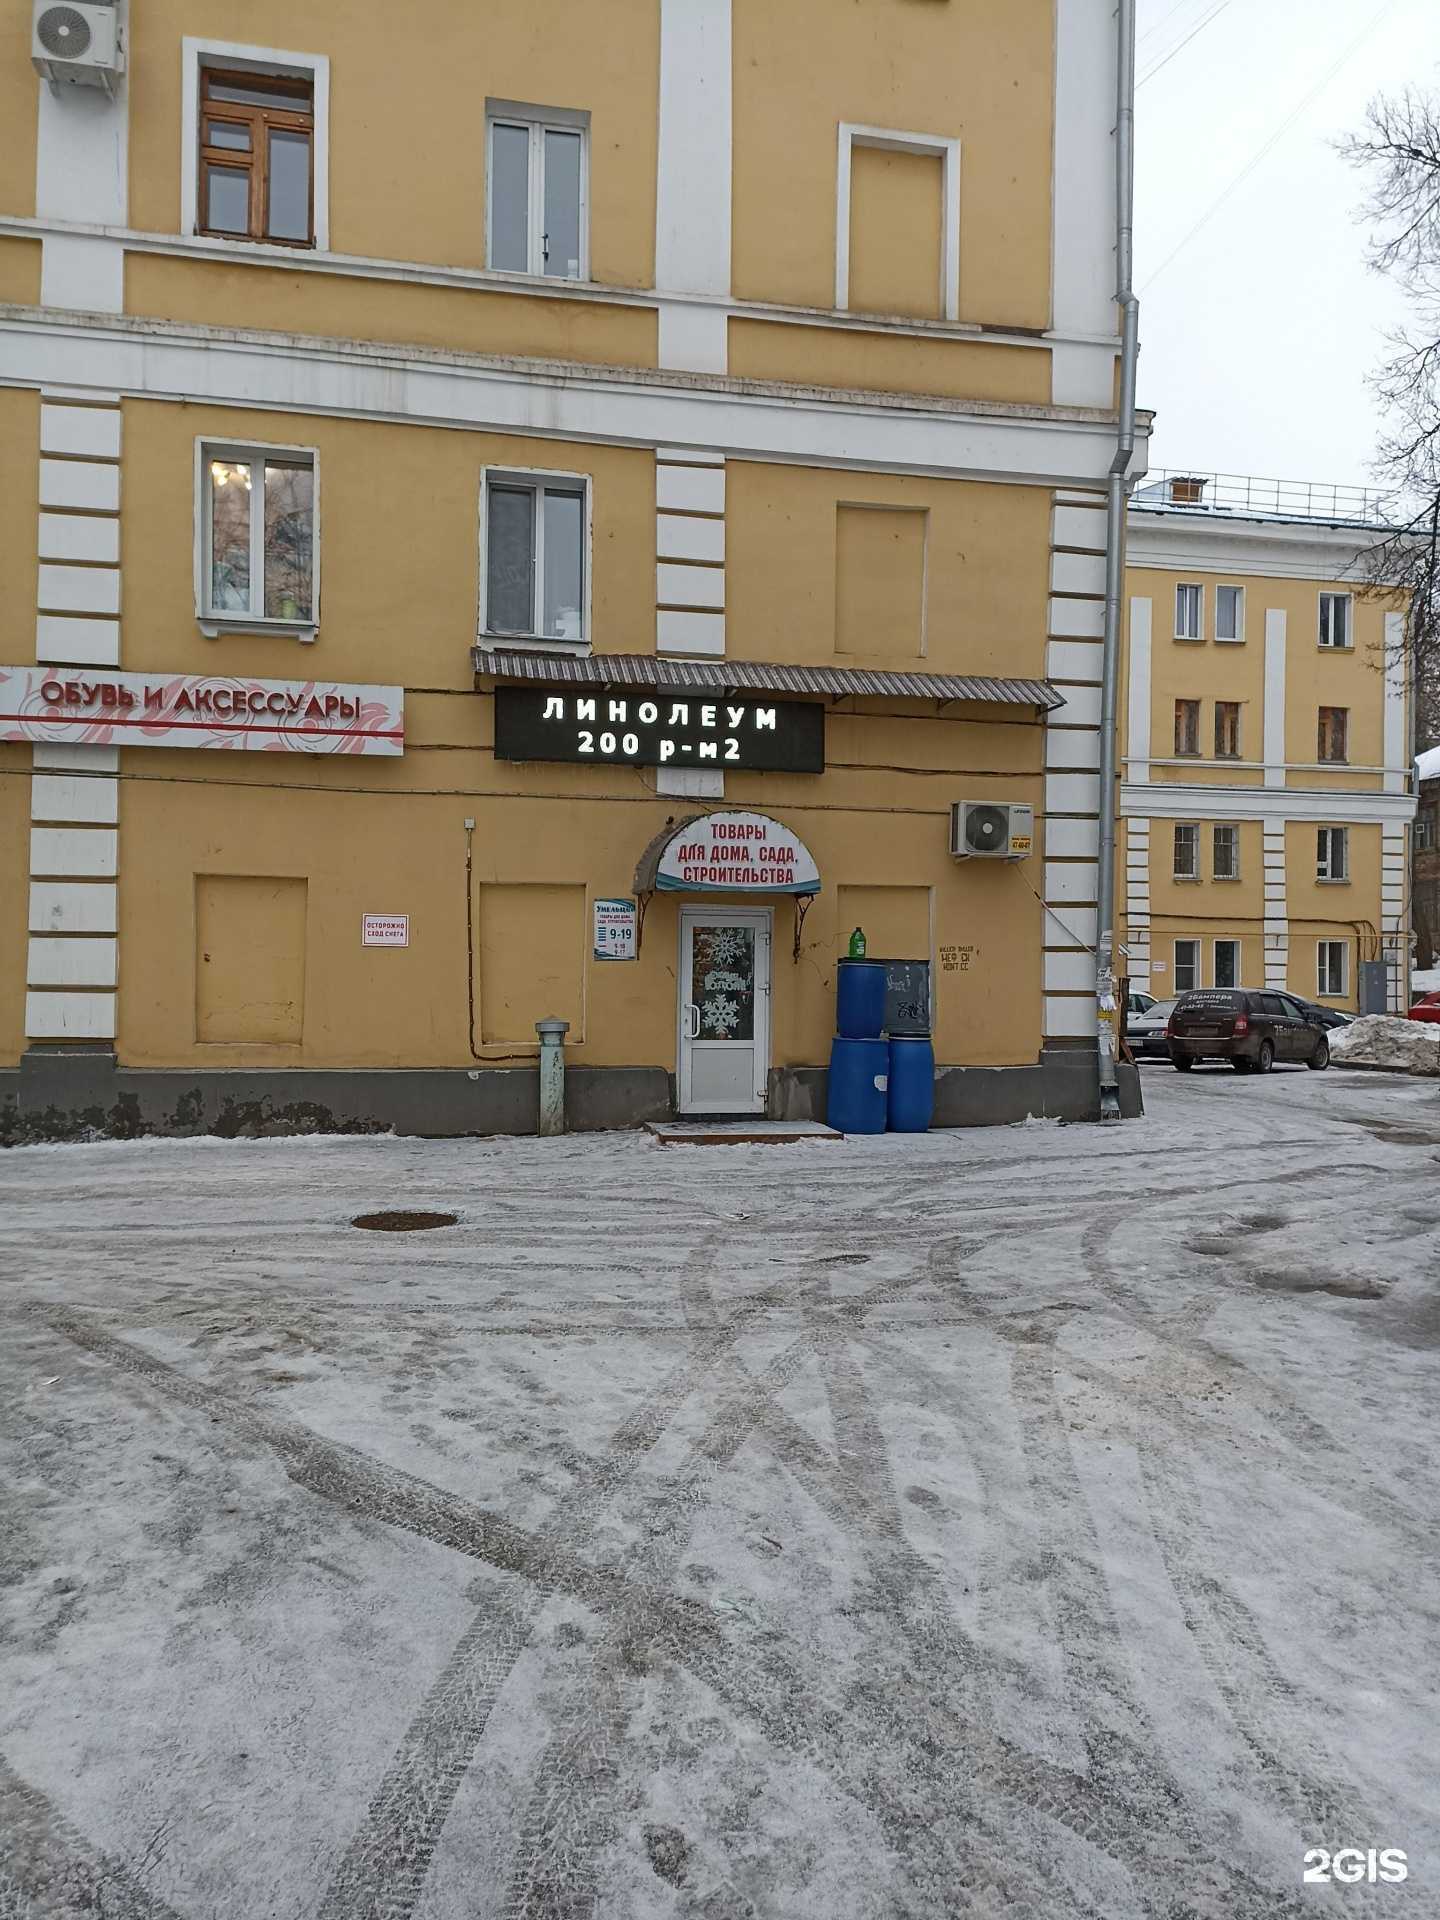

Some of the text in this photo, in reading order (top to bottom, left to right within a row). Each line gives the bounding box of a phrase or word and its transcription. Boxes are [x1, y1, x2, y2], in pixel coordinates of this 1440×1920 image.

[40, 681, 361, 720] ОБУВЬ И АКСЕССУАРЫ
[542, 697, 777, 730] ЛИНОЛЕУМ
[576, 731, 640, 755] 200
[710, 823, 767, 840] ТОВАРЫ
[678, 844, 799, 865] ДЛЯ ДОМА, САДА,
[683, 866, 794, 884] СТРОИТЕЛЬСТВА
[610, 928, 632, 939] 9-19
